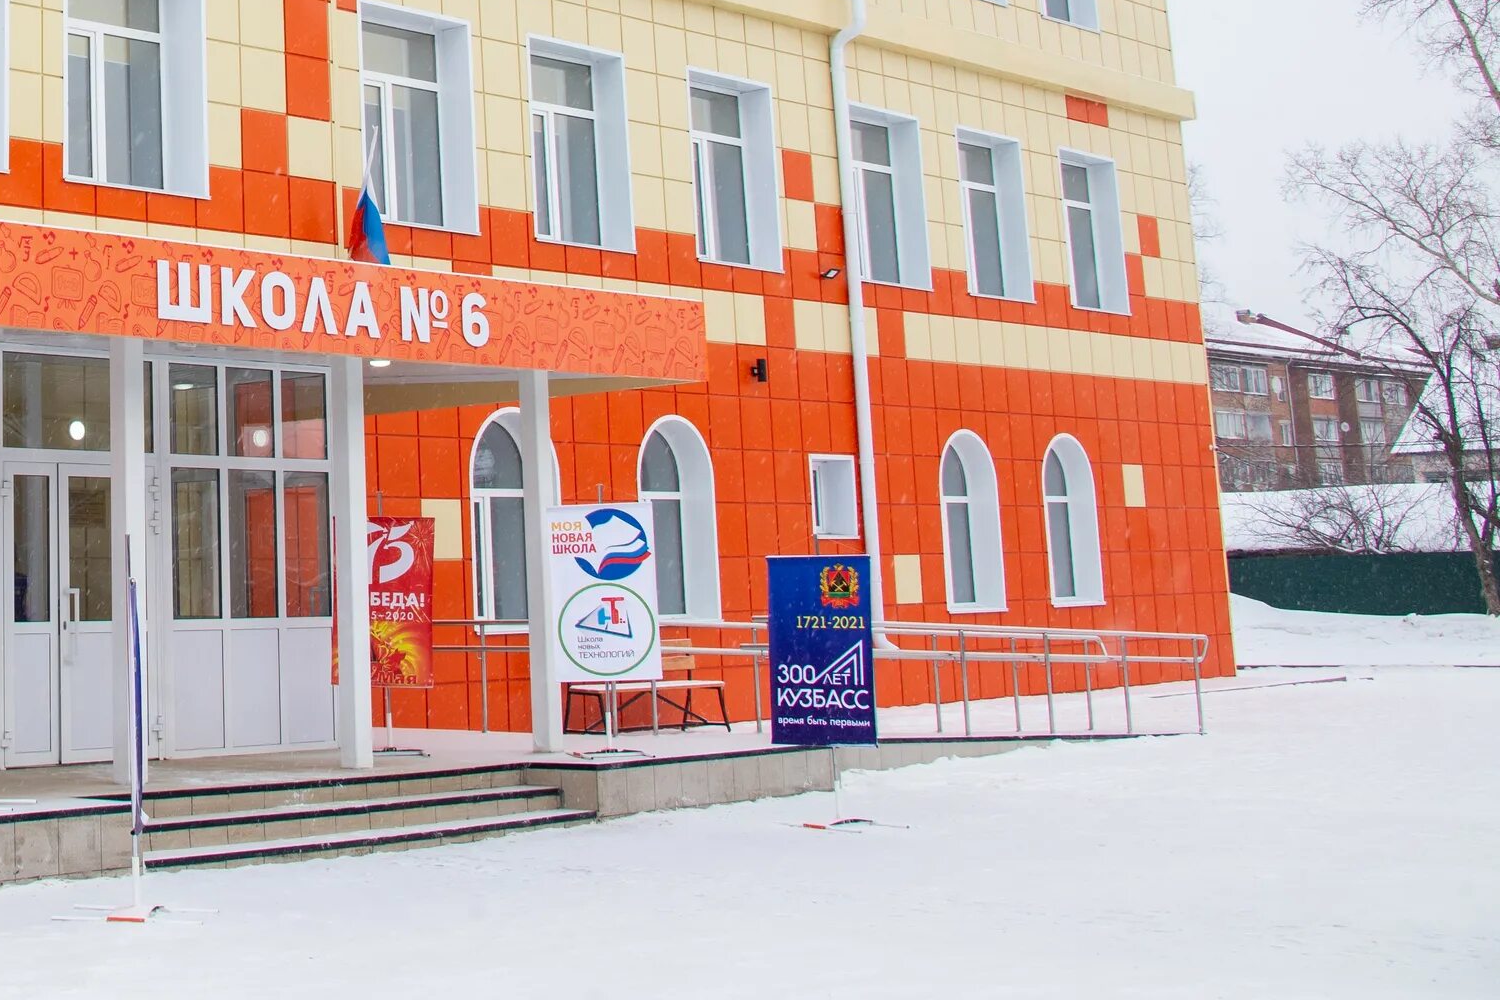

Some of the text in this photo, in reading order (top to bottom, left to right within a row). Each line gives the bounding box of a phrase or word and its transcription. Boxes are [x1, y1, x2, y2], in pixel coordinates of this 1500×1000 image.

[156, 258, 491, 348] ШКОЛА № 6
[551, 521, 582, 531] МОЯ
[552, 532, 593, 543] НОВАЯ
[552, 543, 597, 555] ШКОЛА
[370, 591, 425, 610] БЕДА!
[796, 615, 866, 629] 1721-2021
[577, 635, 603, 643] Школа
[579, 649, 635, 660] ТЕХНОЛОГИЙ
[777, 664, 851, 686] 300 ЛЕТ
[777, 687, 870, 710] КУЗБАСС
[777, 715, 871, 729] время быть первыми
